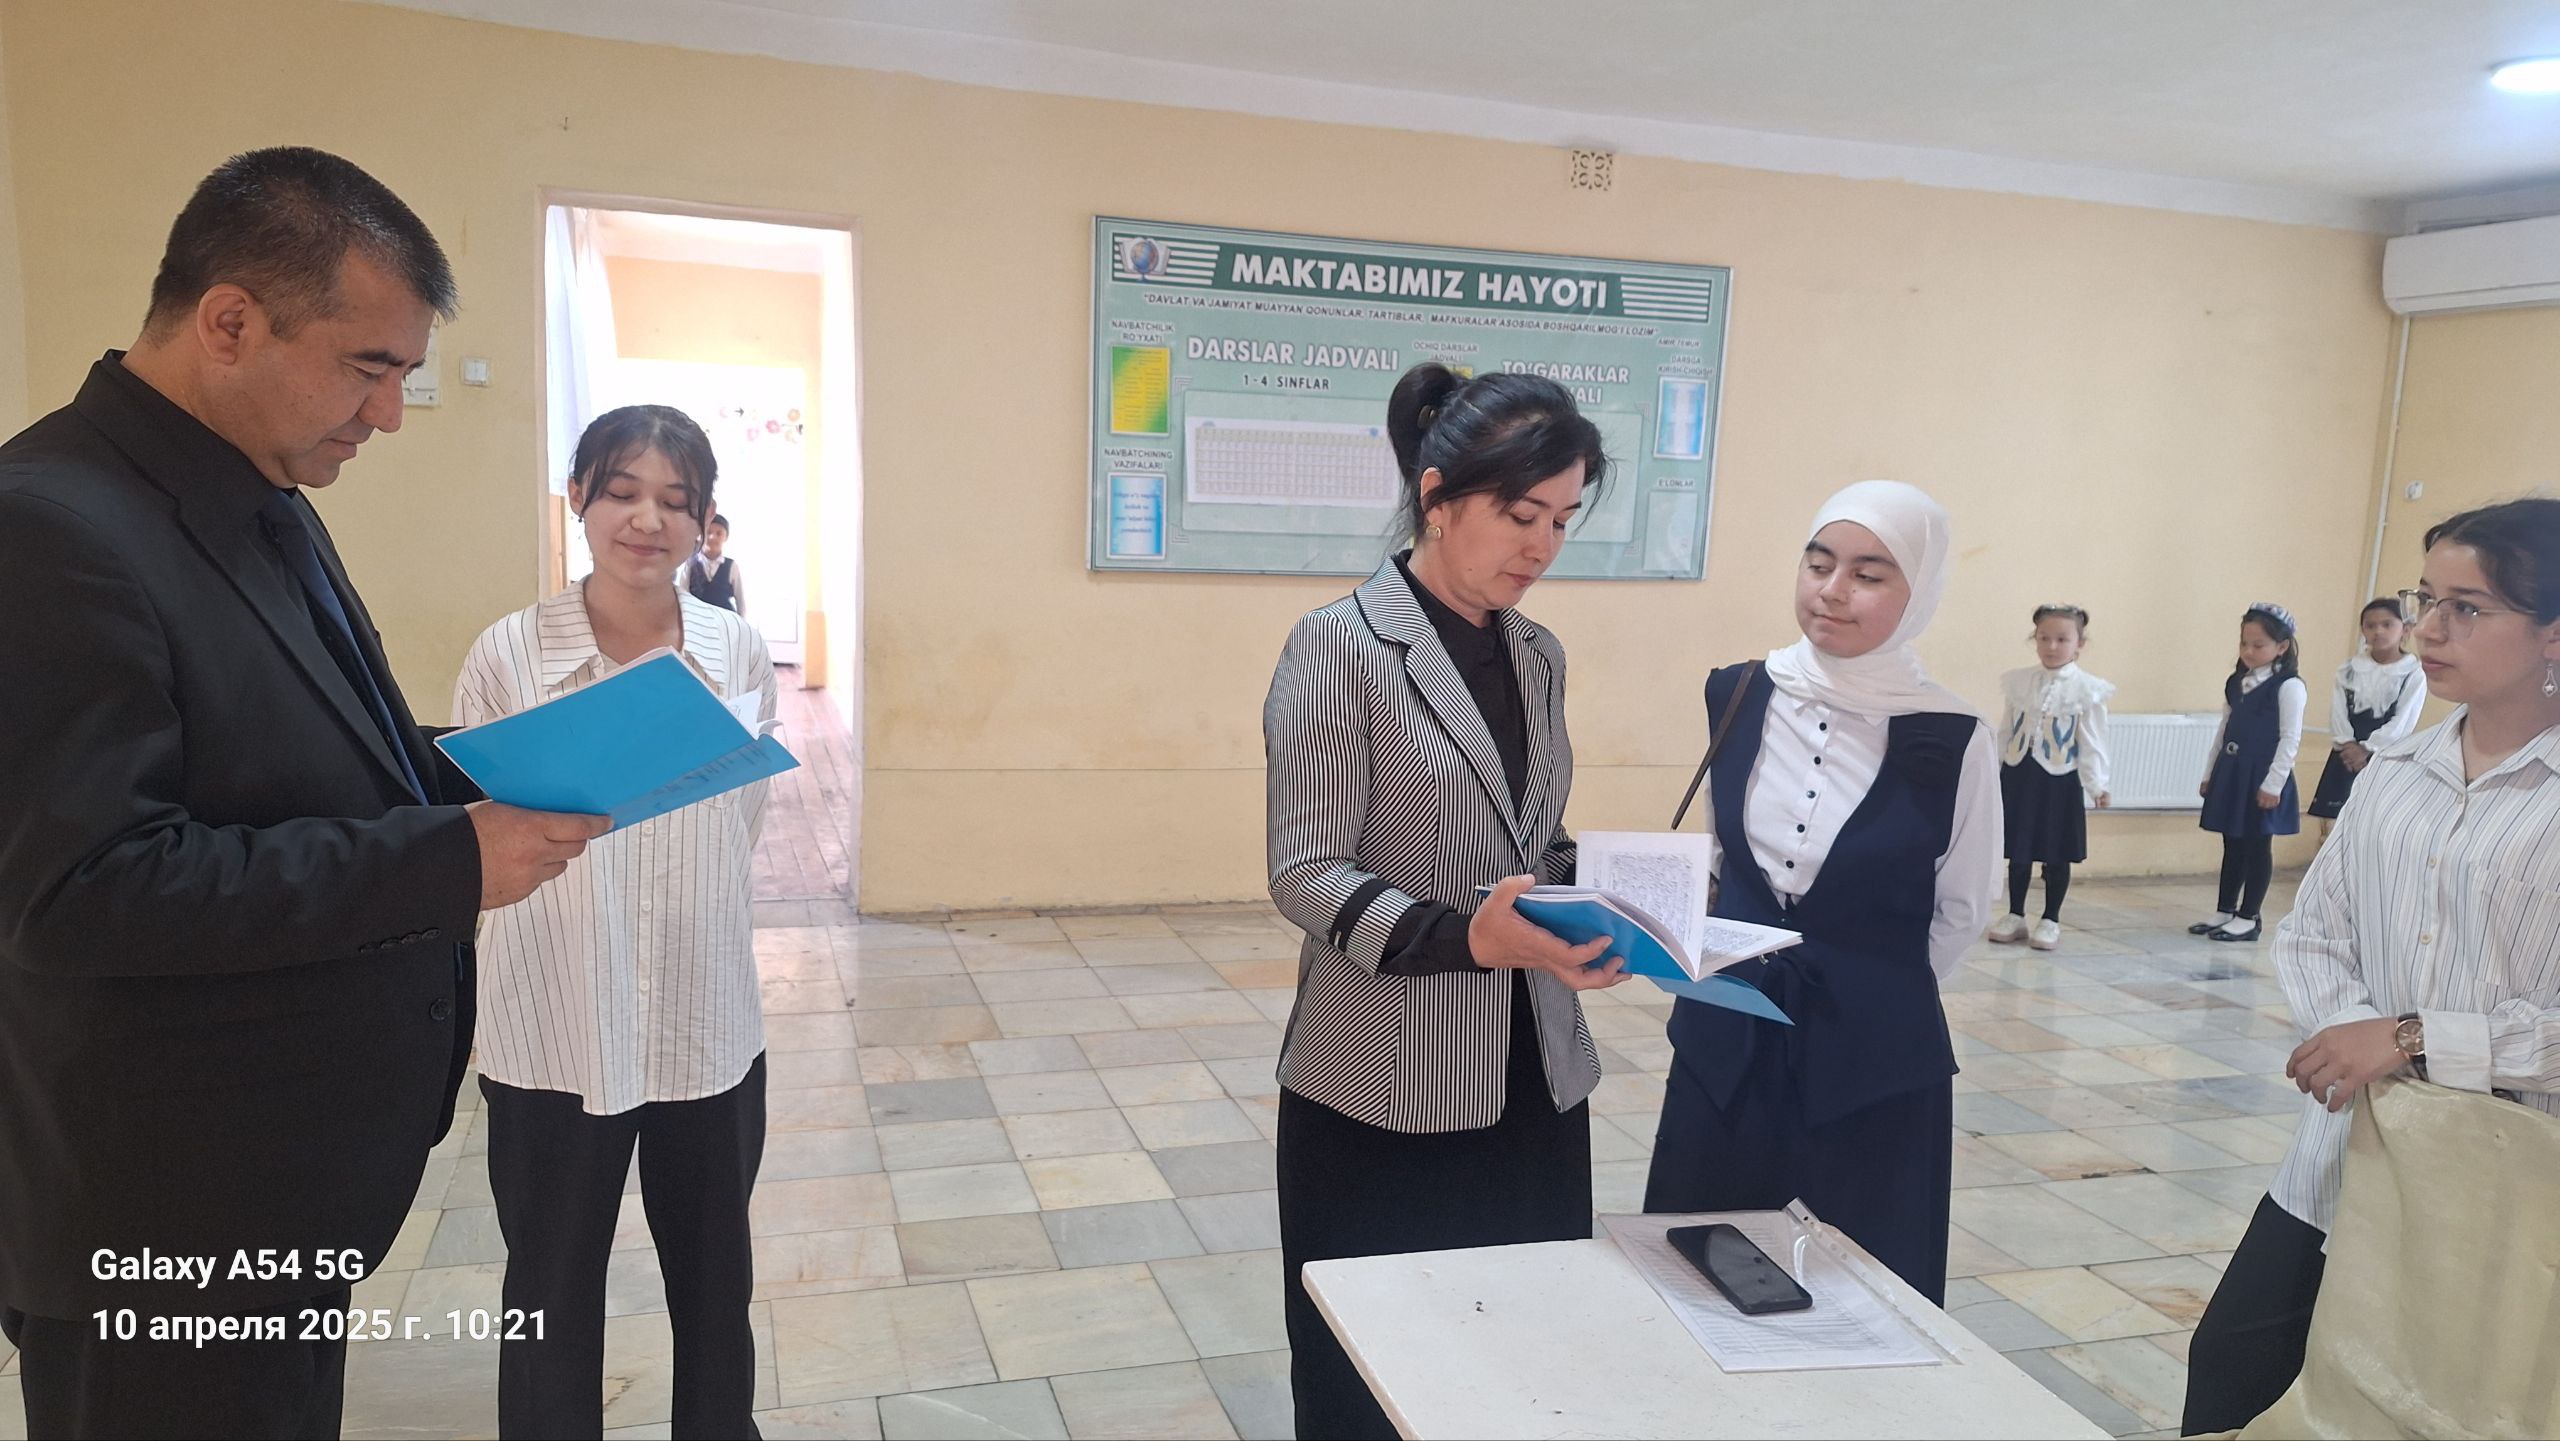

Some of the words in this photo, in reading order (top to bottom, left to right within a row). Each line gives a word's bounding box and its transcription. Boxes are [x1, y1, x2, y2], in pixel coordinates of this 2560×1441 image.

[1232, 253, 1464, 299] MAKTABIMIZ
[1478, 272, 1607, 309] HAYOTI
[1193, 298, 1206, 306] VA
[1209, 299, 1252, 310] JAMIYAT
[1255, 303, 1304, 313] MUAYYAN
[1431, 314, 1497, 326] MAFKURALAR
[1499, 319, 1540, 329] ASOSIDA
[1112, 320, 1175, 332] NAVBATCHILIK
[1187, 337, 1295, 364] DARSLAR
[1303, 343, 1398, 371] JADVALI
[1277, 376, 1330, 390] SINFLAR
[1104, 448, 1173, 459] NAVBATCHINING
[1114, 461, 1163, 469] VAZIFALARI
